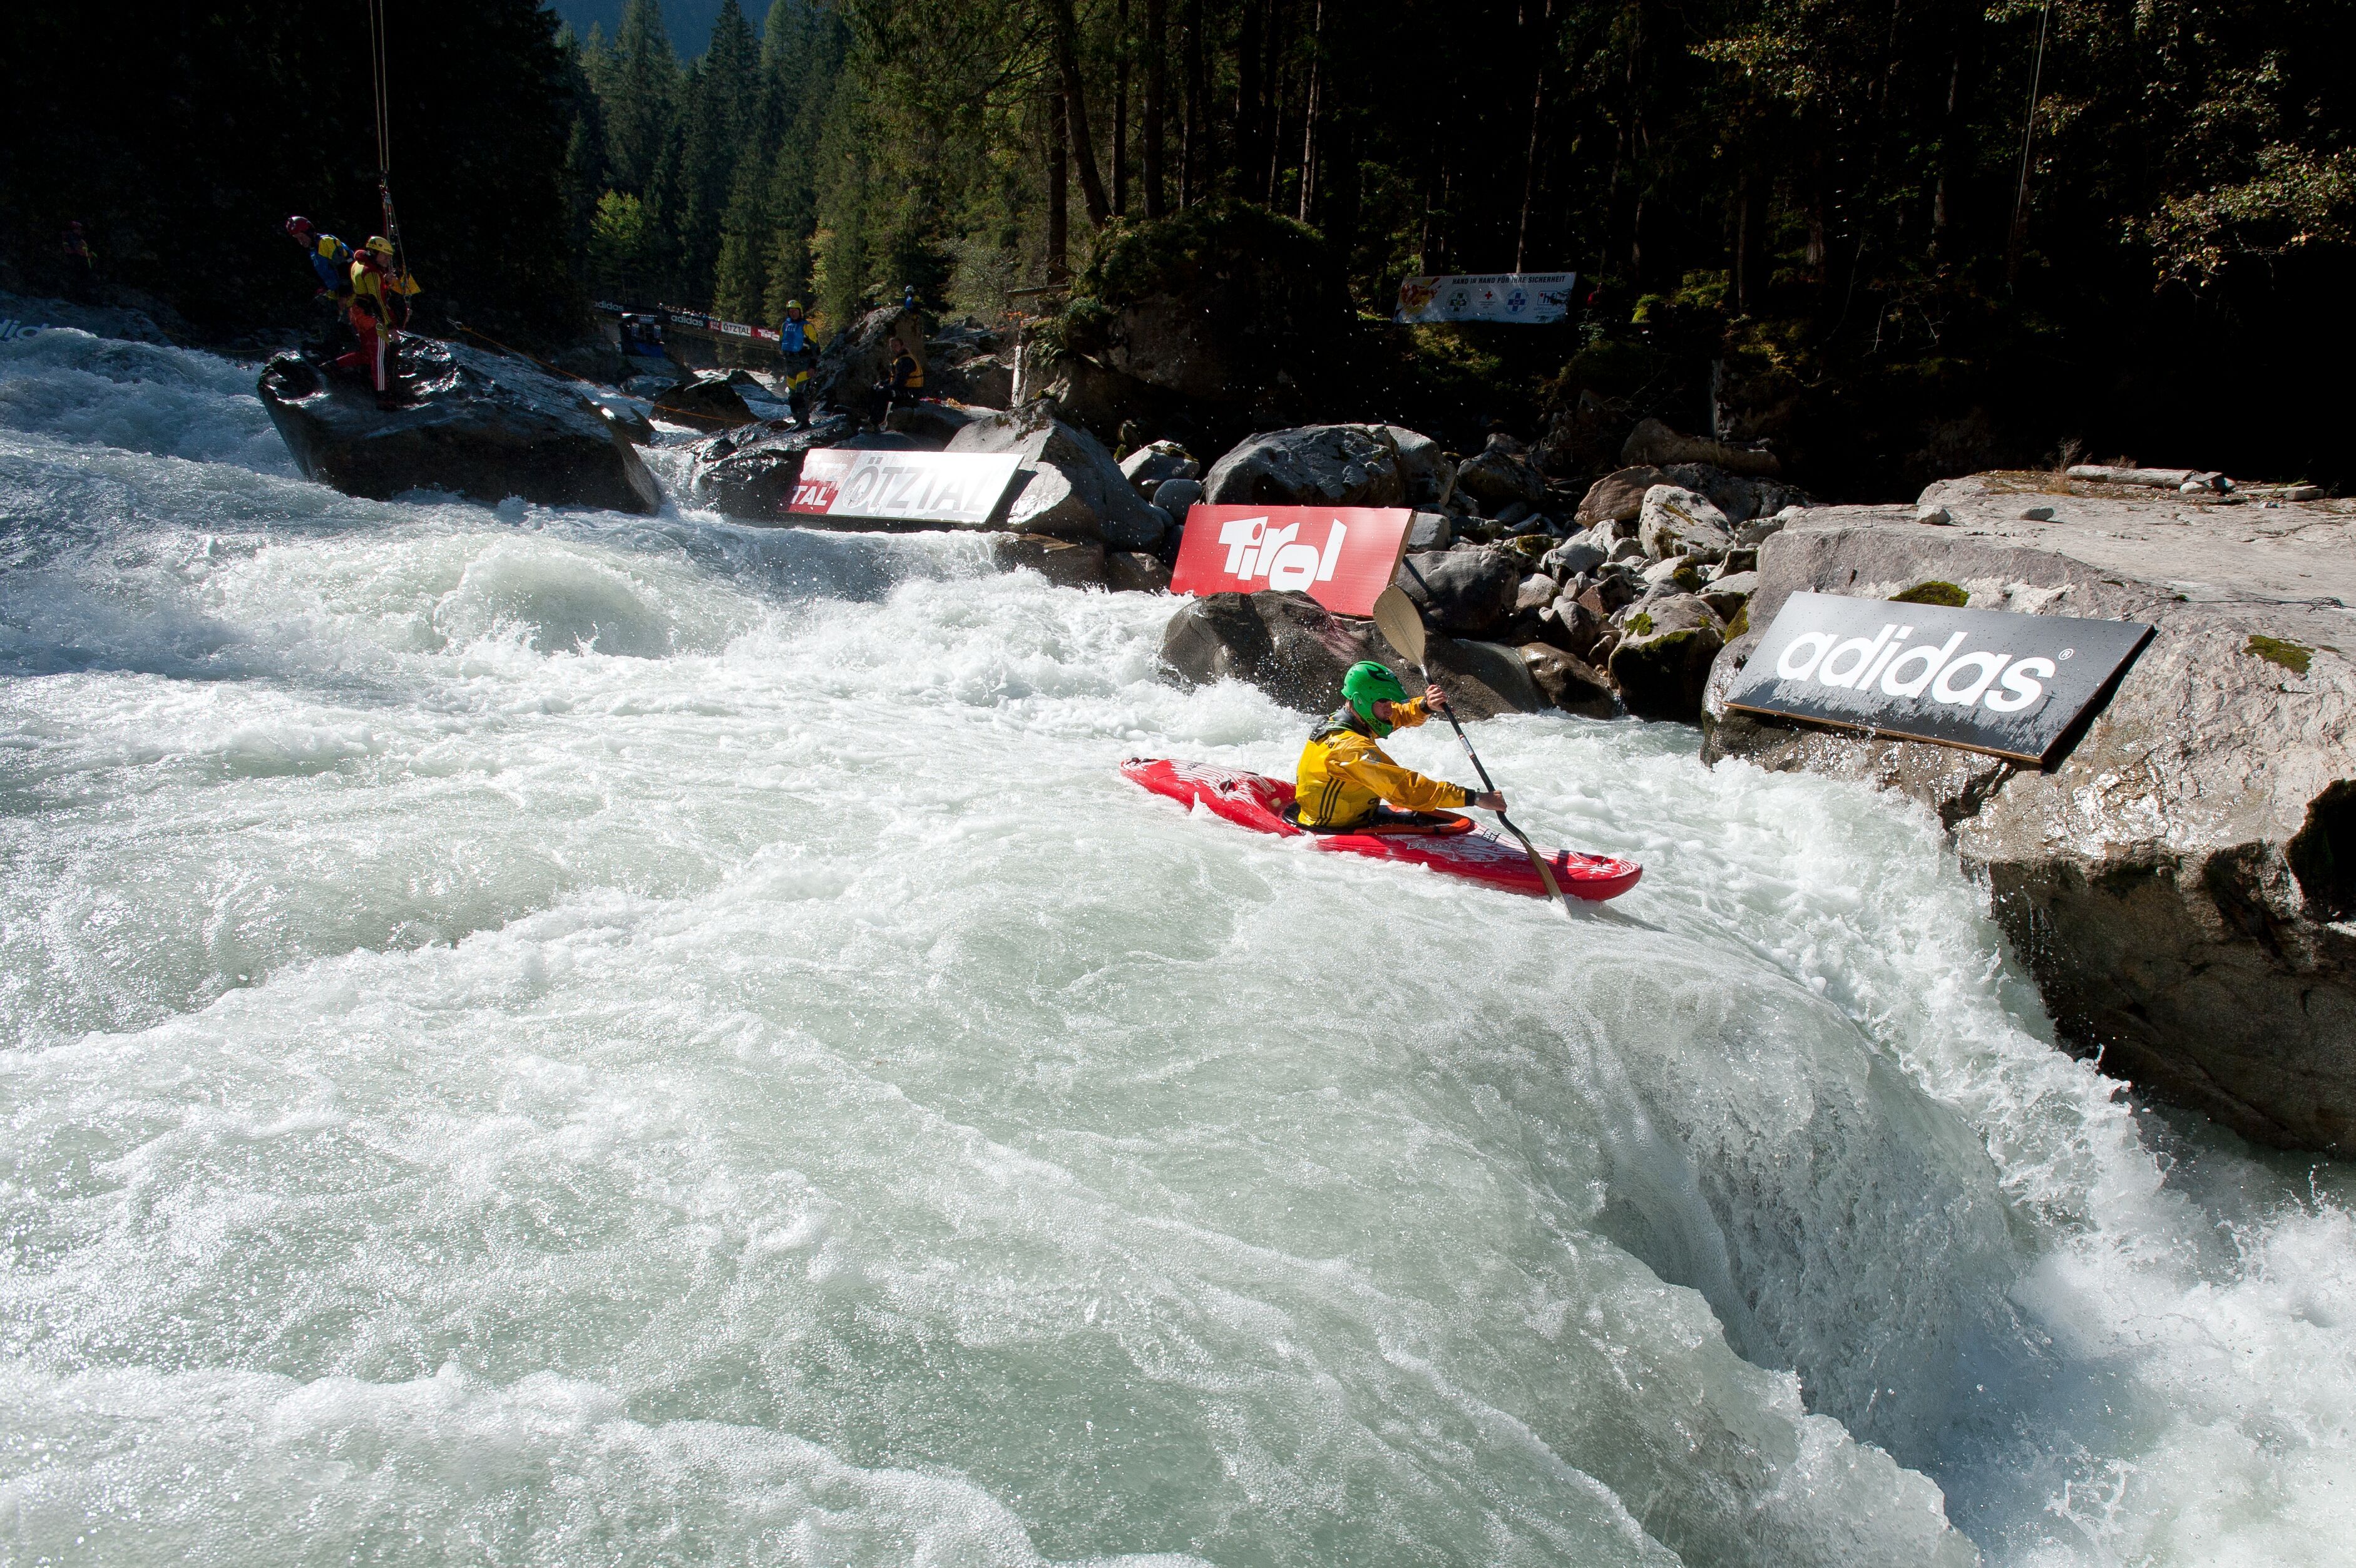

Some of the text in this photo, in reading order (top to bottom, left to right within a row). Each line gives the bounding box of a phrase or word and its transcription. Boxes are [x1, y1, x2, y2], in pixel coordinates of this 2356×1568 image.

[1528, 275, 1566, 284] SICHERHEIT
[670, 315, 704, 327] adidas
[724, 322, 750, 335] ÖTZTAL
[842, 456, 992, 511] ÖTZTAL
[791, 485, 827, 506] TAL
[1217, 516, 1348, 592] Tirol
